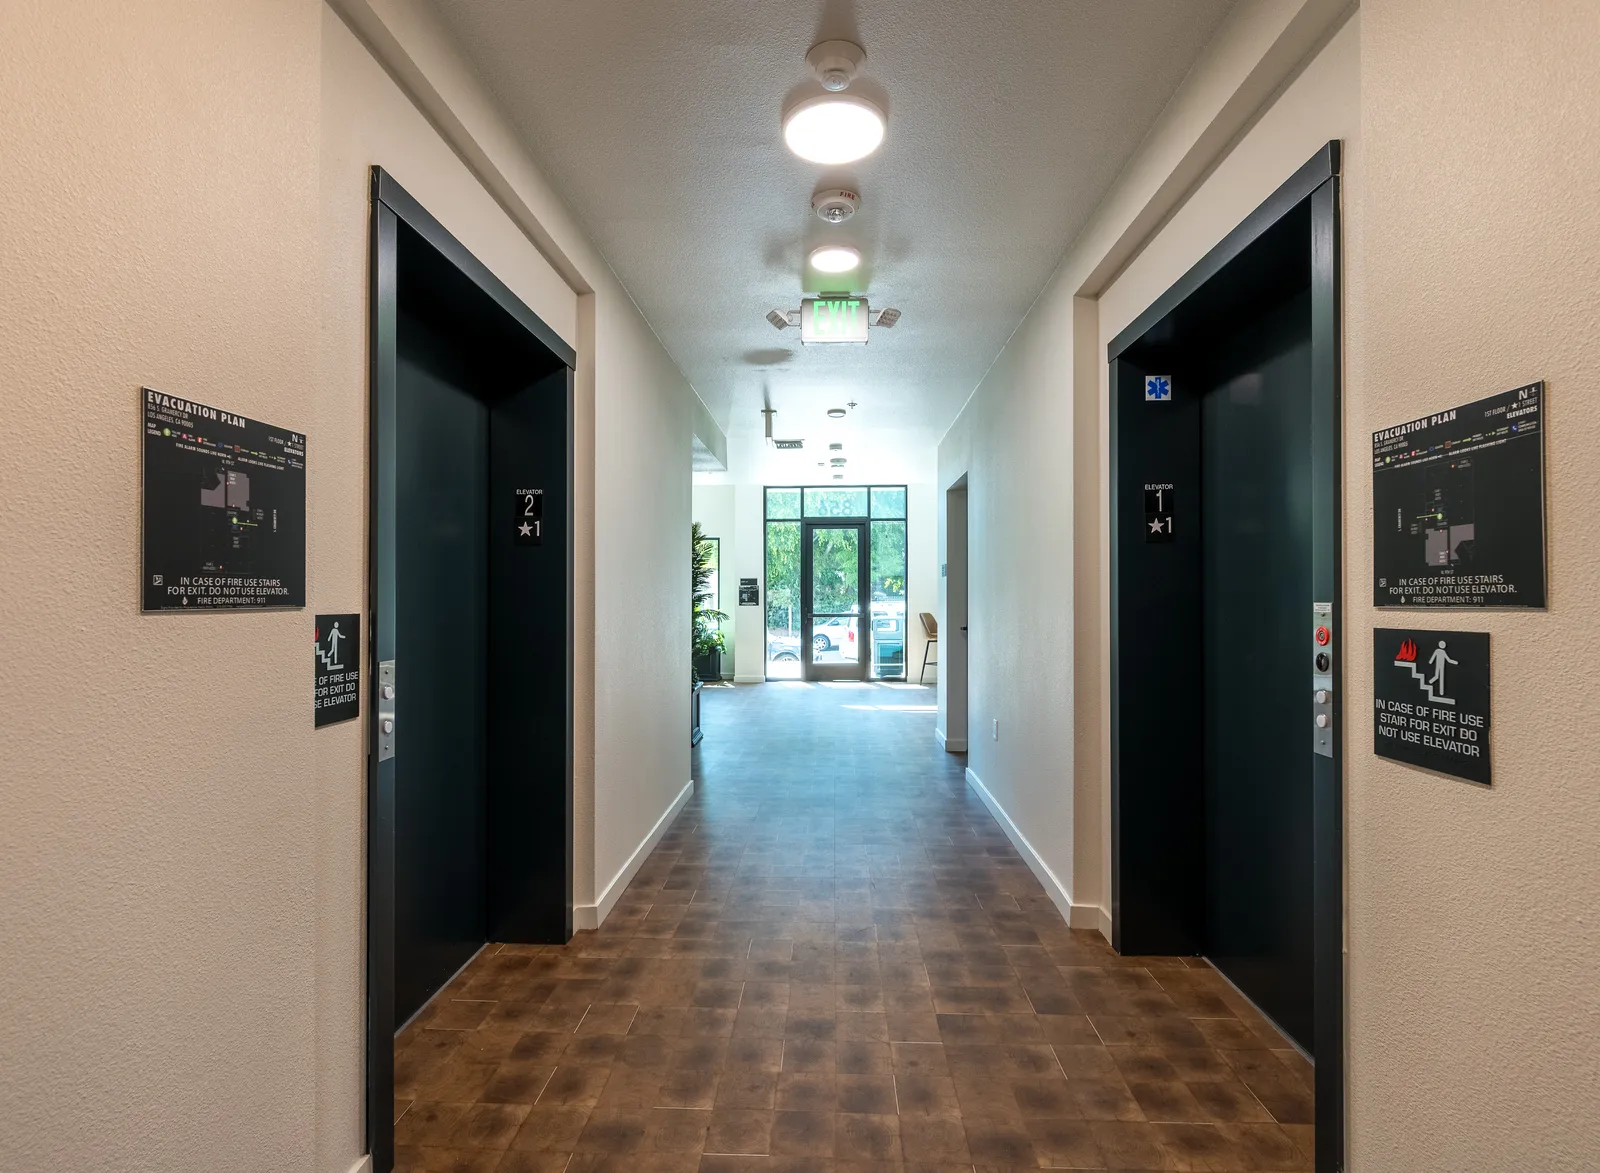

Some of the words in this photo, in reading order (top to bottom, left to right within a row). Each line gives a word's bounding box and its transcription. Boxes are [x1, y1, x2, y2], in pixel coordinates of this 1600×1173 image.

[840, 191, 856, 200] FIRE
[813, 300, 860, 336] EXIT
[1518, 389, 1528, 400] N
[147, 391, 216, 420] EVACUATION
[221, 412, 246, 428] PLAN
[1492, 406, 1506, 415] FLOOR
[1507, 405, 1537, 419] ELEVATORS
[1374, 417, 1428, 442] EVACUATION
[1431, 410, 1456, 426] PLAN
[292, 434, 298, 442] N
[524, 494, 534, 516] 2
[1156, 490, 1162, 512] 1
[193, 577, 213, 585] CASE
[228, 578, 242, 586] FIRE
[1408, 578, 1427, 586] CASE
[1428, 577, 1438, 585] OF
[1440, 577, 1455, 585] FIRE
[1457, 576, 1473, 584] USE
[1475, 575, 1503, 584] STAIRS
[168, 586, 186, 595] FOR
[188, 587, 207, 595] EXIT.
[1423, 586, 1434, 594] DO
[1454, 585, 1470, 593] USE
[1472, 584, 1517, 593] ELEVATOR.
[319, 676, 328, 685] OF
[330, 673, 344, 683] FIRE
[346, 671, 358, 680] USE
[330, 684, 344, 694] EXIT
[346, 682, 355, 692] DO
[324, 693, 356, 707] ELEVATOR
[1376, 699, 1385, 710] IN
[1388, 701, 1413, 715] CASE
[1416, 705, 1429, 718] OF
[1433, 708, 1456, 723] FIRE
[1460, 714, 1484, 728] USE
[1380, 713, 1406, 727] STAIR
[1410, 719, 1430, 732] FOR
[1433, 724, 1457, 738] EXIT
[1460, 728, 1477, 742] DO
[1378, 725, 1398, 738] NOT
[1401, 730, 1421, 744] USE
[1424, 735, 1480, 757] ELEVATOR
